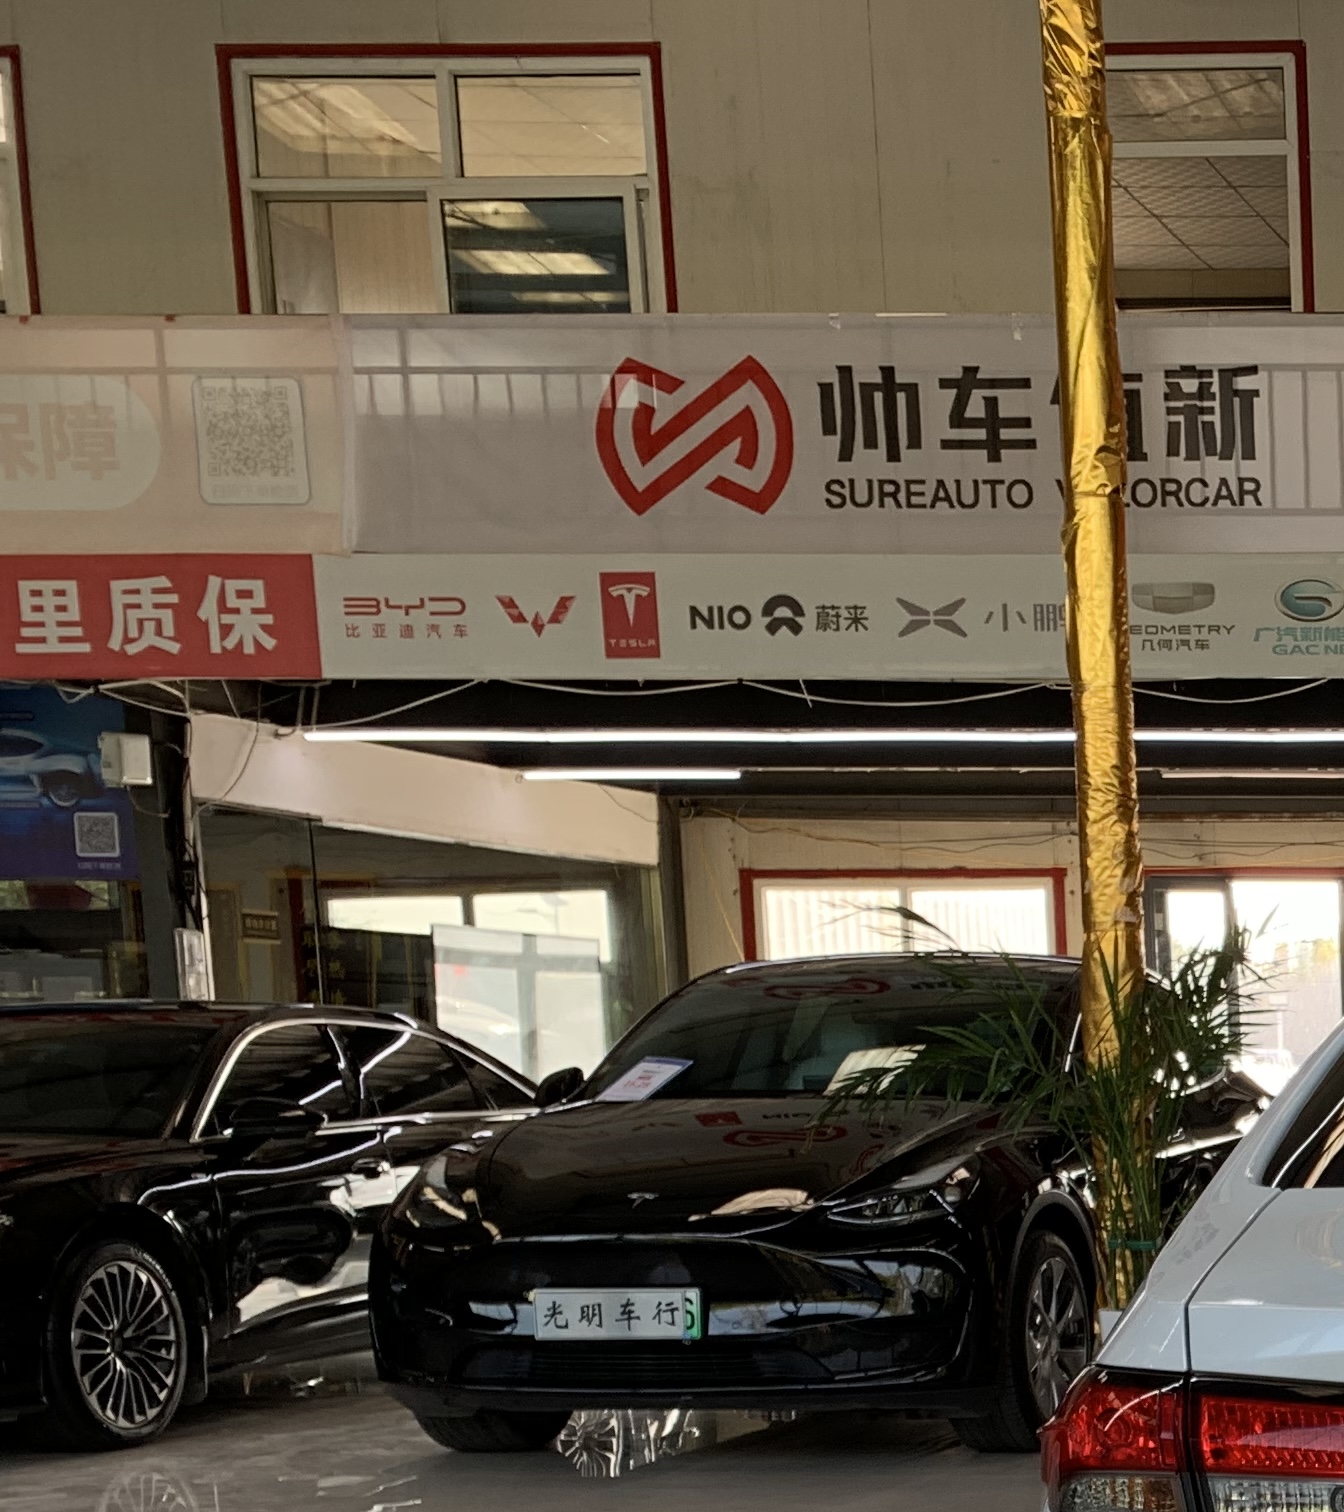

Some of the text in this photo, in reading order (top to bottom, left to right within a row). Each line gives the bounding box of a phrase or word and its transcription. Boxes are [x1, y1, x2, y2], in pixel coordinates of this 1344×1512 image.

[824, 477, 1263, 510] SUREAUTO ORCAR
[15, 574, 278, 655] 里质保
[343, 596, 467, 616] BYD
[689, 603, 869, 632] NIO 蔚来
[345, 623, 468, 639] 比亚迪汽车
[1129, 624, 1236, 635] EOMETRY
[608, 638, 656, 648] TESLA
[1141, 638, 1210, 652] 几何汽车
[1272, 643, 1320, 656] GAC
[543, 1297, 679, 1332] 光明车行
